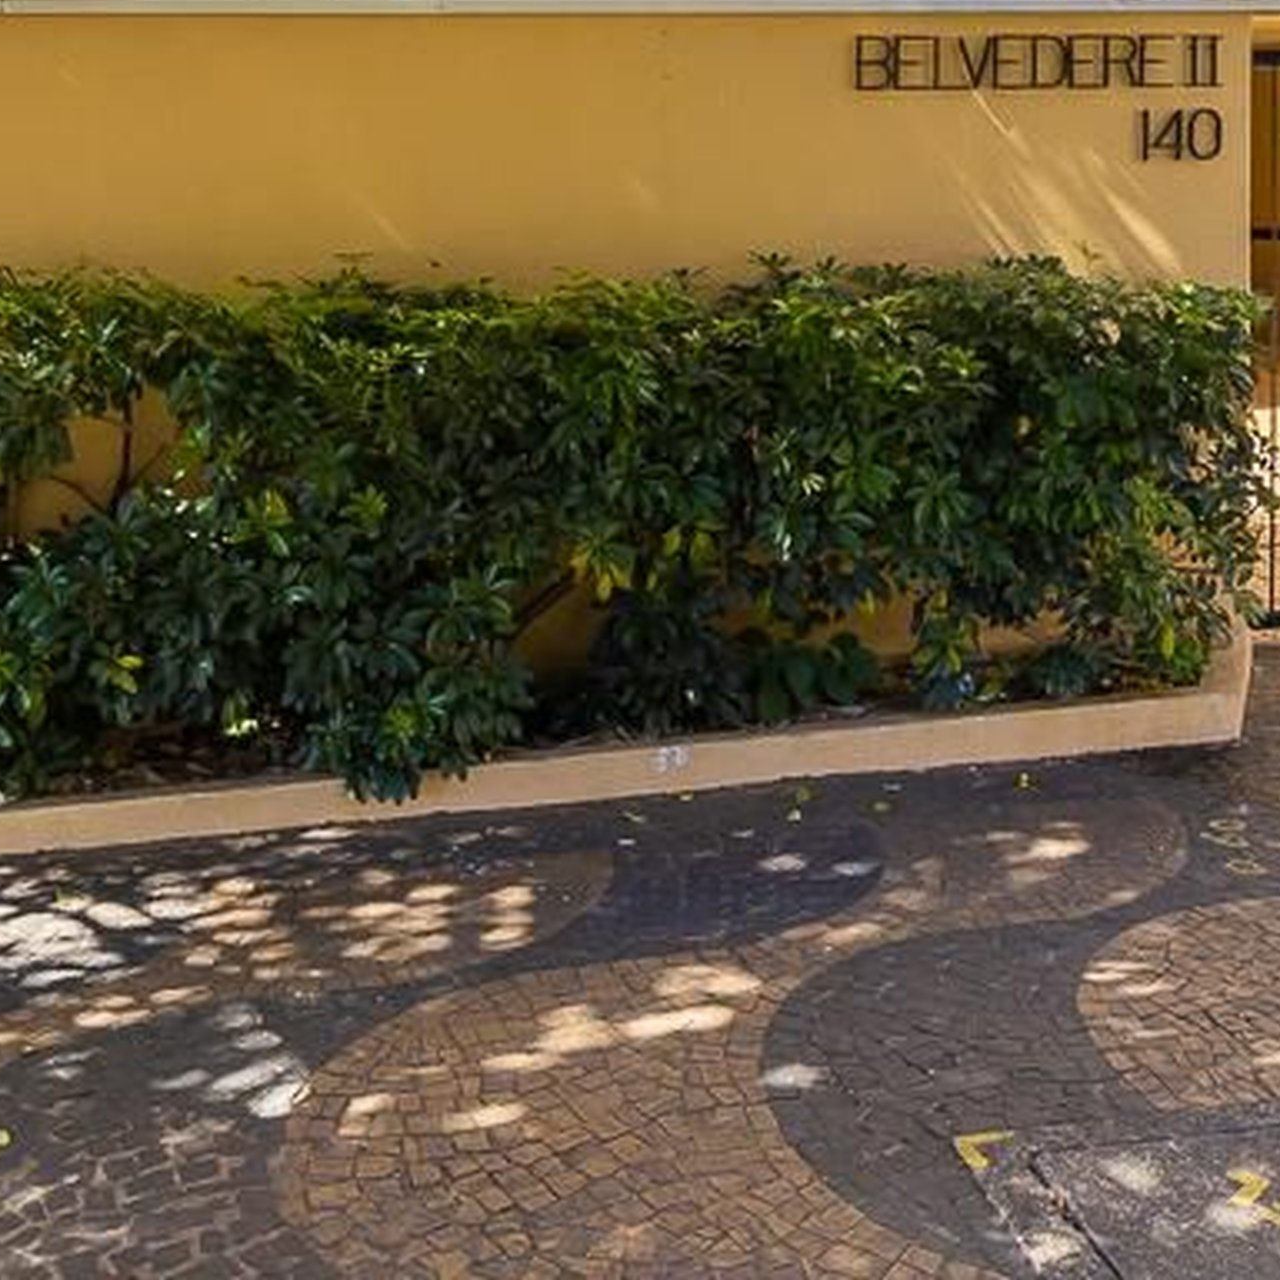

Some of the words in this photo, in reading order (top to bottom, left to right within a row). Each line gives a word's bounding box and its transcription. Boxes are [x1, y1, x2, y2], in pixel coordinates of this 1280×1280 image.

[854, 34, 1174, 90] BELVEDERE
[1182, 34, 1223, 88] II
[1139, 107, 1222, 161] 140
